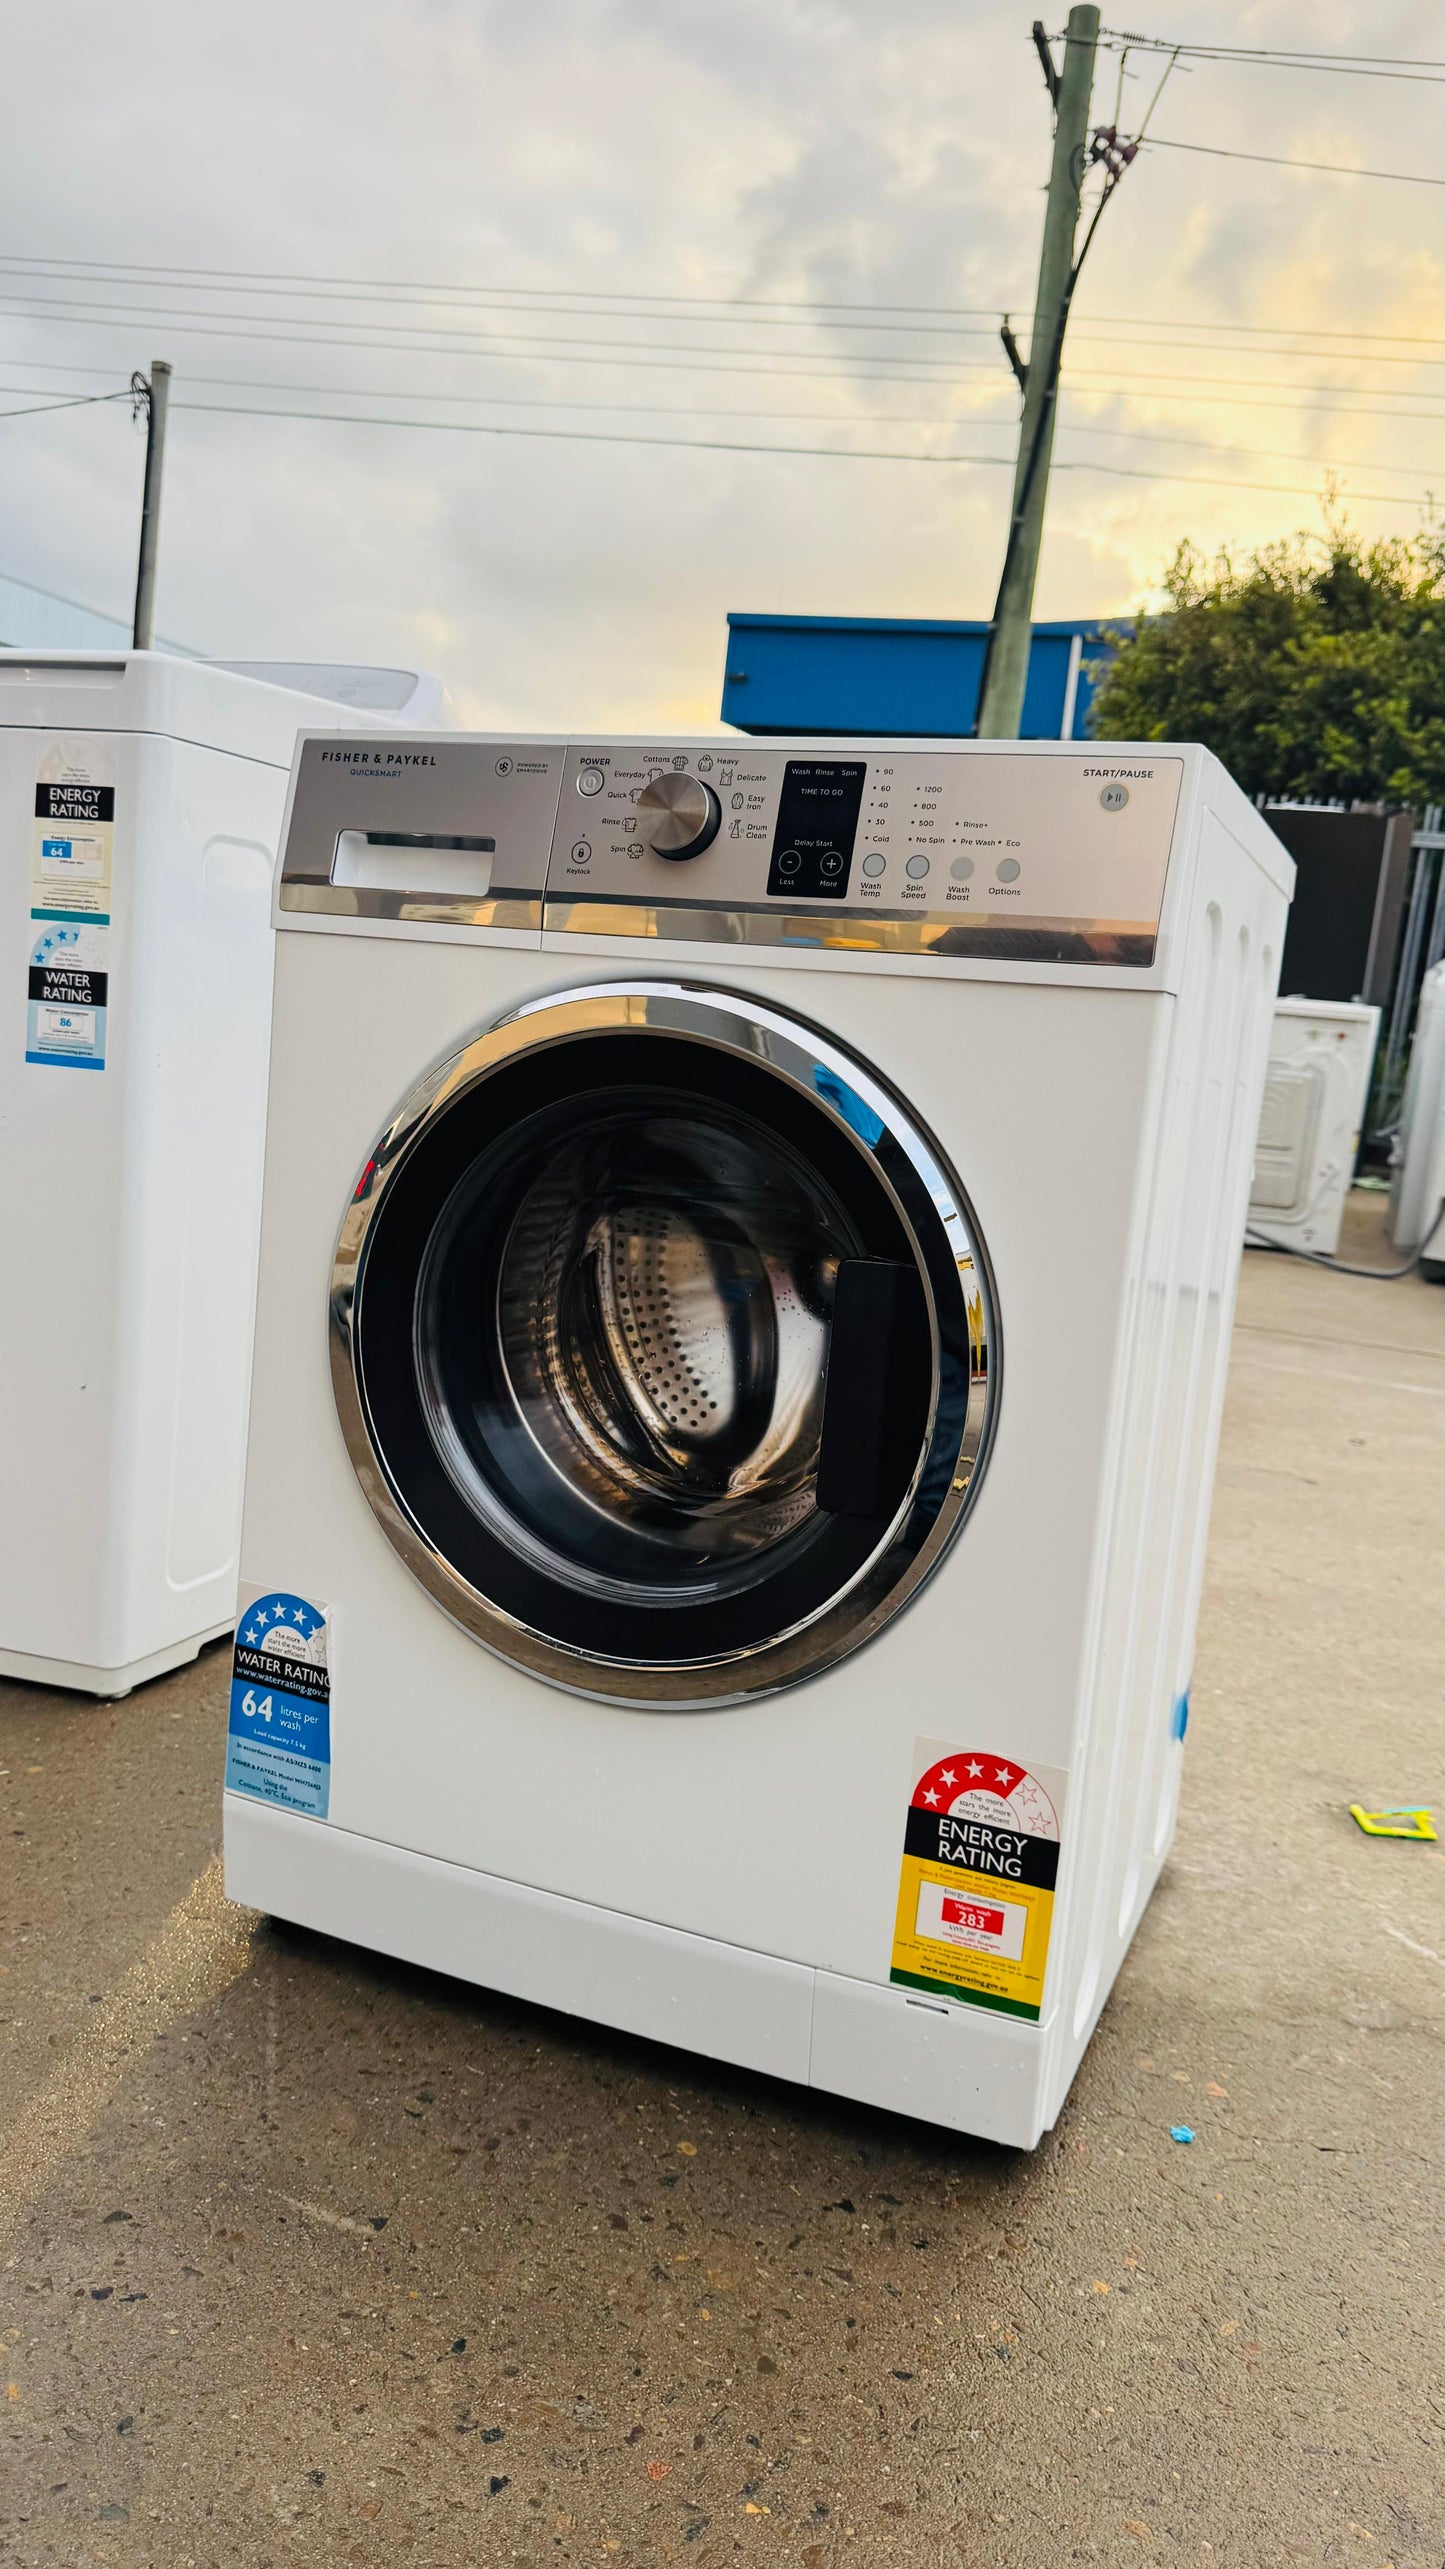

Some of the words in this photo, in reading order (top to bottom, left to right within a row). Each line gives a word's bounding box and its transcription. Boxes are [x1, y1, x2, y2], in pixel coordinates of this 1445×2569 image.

[322, 752, 369, 763] FISHER
[374, 754, 381, 763] &
[387, 755, 436, 766] PAYKEL
[580, 758, 611, 766] POWER
[643, 755, 671, 764] Cottons
[717, 758, 740, 766] Heavy
[350, 768, 402, 778] QUICKSMART
[614, 770, 646, 779] Everyday
[883, 768, 894, 776] 90
[1083, 769, 1154, 779] START/PAUSE
[737, 774, 768, 782] Delicate
[49, 787, 101, 803] ENERGY
[607, 791, 627, 799] Quick
[801, 788, 818, 796] TIME
[820, 788, 830, 796] TO
[831, 789, 844, 797] GO
[748, 795, 766, 803] Easy
[50, 803, 99, 818] RATING
[921, 803, 937, 811] 800
[746, 832, 767, 840] Clean
[916, 836, 927, 844] No
[929, 837, 946, 845] Spin
[794, 839, 814, 848] Delay
[815, 840, 834, 848] Start
[960, 838, 973, 846] Pre
[975, 839, 997, 847] Wash
[50, 847, 63, 856] 64
[779, 878, 795, 886] Less
[820, 880, 838, 888] More
[860, 882, 882, 890] Wash
[860, 889, 881, 898] Temp
[906, 885, 924, 893] Spin
[948, 886, 970, 894] Wash
[988, 887, 1022, 896] Options
[901, 891, 926, 900] Speed
[946, 893, 970, 901] Boost
[45, 971, 91, 988] WATER
[43, 986, 93, 1003] RATING
[60, 1017, 72, 1027] 86
[275, 1631, 285, 1640] The
[286, 1635, 301, 1643] more
[267, 1637, 281, 1646] stars
[281, 1641, 291, 1649] the
[292, 1645, 307, 1653] more
[267, 1646, 283, 1654] water
[284, 1650, 306, 1660] efficient
[238, 1650, 281, 1674] WATER
[242, 1689, 273, 1722] 64
[280, 1705, 302, 1720] litres
[304, 1714, 319, 1724] per
[280, 1719, 302, 1732] wash
[253, 1728, 267, 1737] Load
[268, 1734, 290, 1745] capacity
[969, 1792, 983, 1802] The
[986, 1798, 1004, 1807] more
[959, 1800, 975, 1809] stars
[978, 1804, 990, 1812] the
[993, 1809, 1012, 1818] more
[959, 1808, 981, 1819] energy
[984, 1814, 1011, 1826] efficient
[938, 1818, 1028, 1856] ENERGY
[938, 1840, 1022, 1878] RATING
[944, 1887, 964, 1900] Energy
[967, 1895, 1006, 1909] consumption
[958, 1911, 985, 1930] 283
